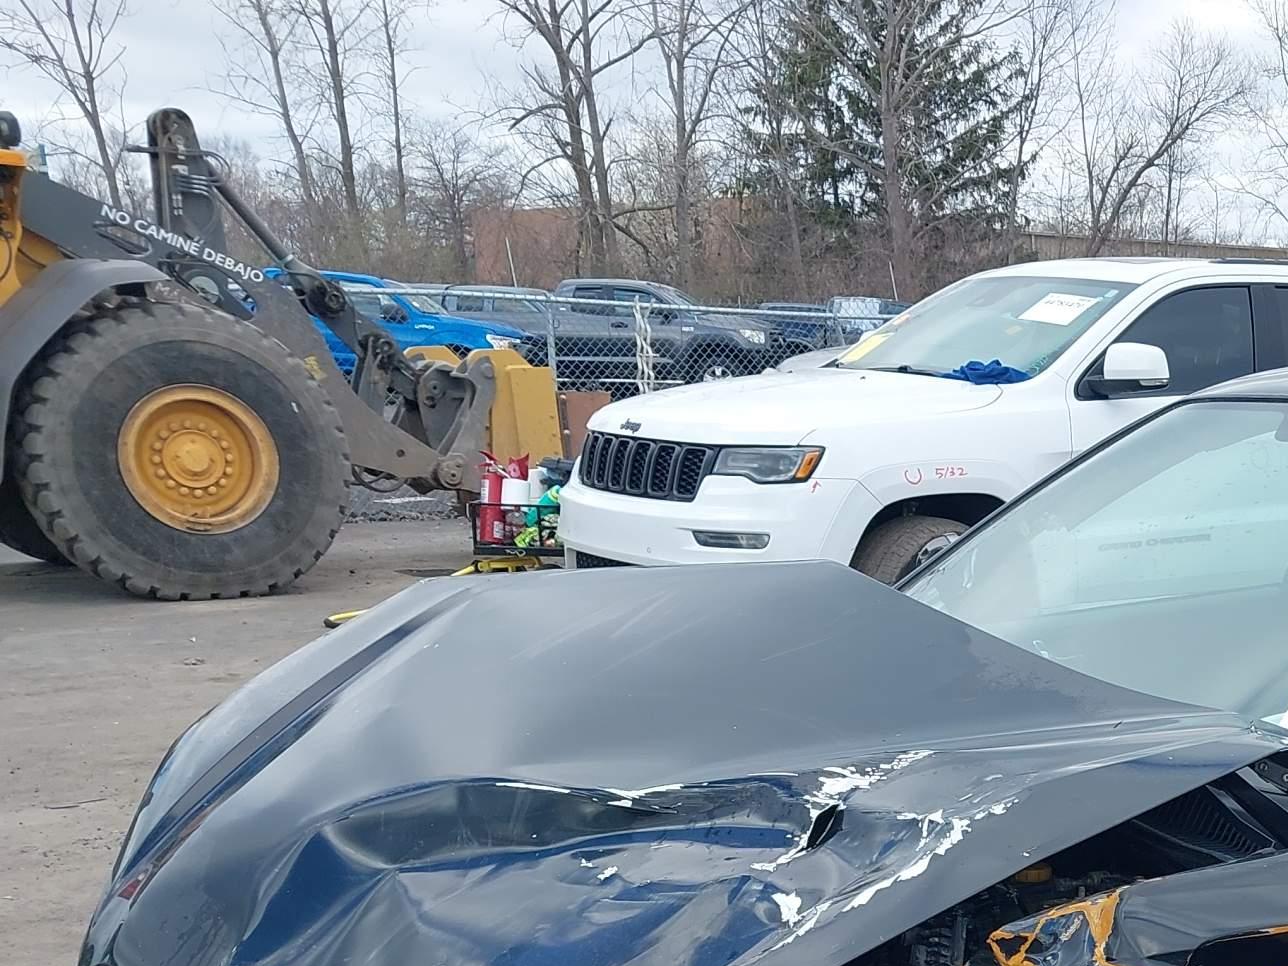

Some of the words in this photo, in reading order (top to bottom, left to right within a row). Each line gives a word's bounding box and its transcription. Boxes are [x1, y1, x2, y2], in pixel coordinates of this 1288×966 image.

[101, 205, 131, 224] NO
[202, 248, 264, 282] DEBAJO
[935, 466, 969, 479] 5/32
